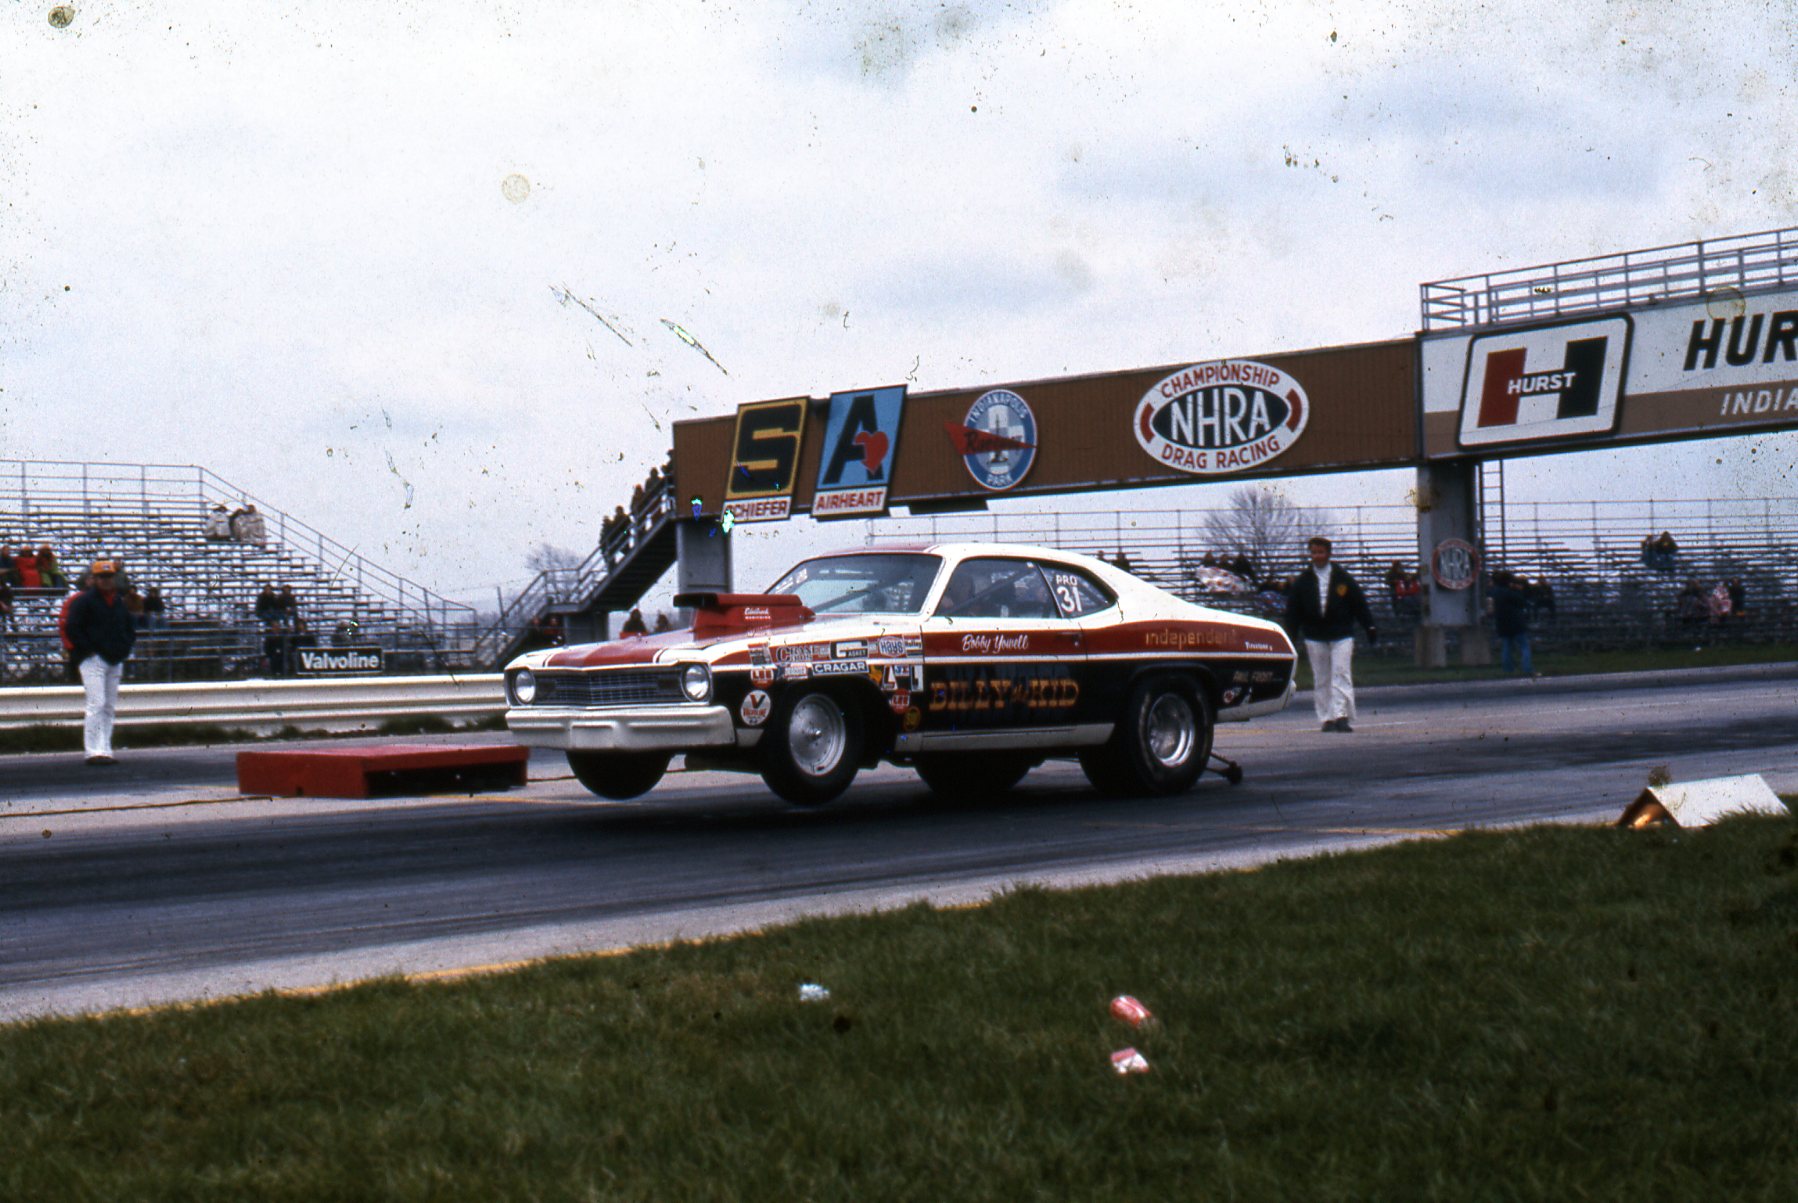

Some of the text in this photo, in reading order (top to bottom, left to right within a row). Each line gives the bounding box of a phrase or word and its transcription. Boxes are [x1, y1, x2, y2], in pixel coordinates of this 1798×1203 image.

[1160, 364, 1281, 398] CHAMPIONSHIP
[1508, 372, 1576, 395] HURST
[1170, 387, 1272, 447] NHRA
[1161, 434, 1281, 469] DRAG RACING
[816, 491, 884, 511] AIRHEART
[1056, 575, 1077, 586] PRO
[1057, 586, 1082, 613] 31
[880, 640, 903, 654] Hays
[962, 633, 991, 653] Bobby
[301, 652, 379, 669] Valvoline
[814, 662, 866, 674] CRAGAR
[929, 679, 1012, 711] BILLY
[1028, 678, 1080, 708] KID
